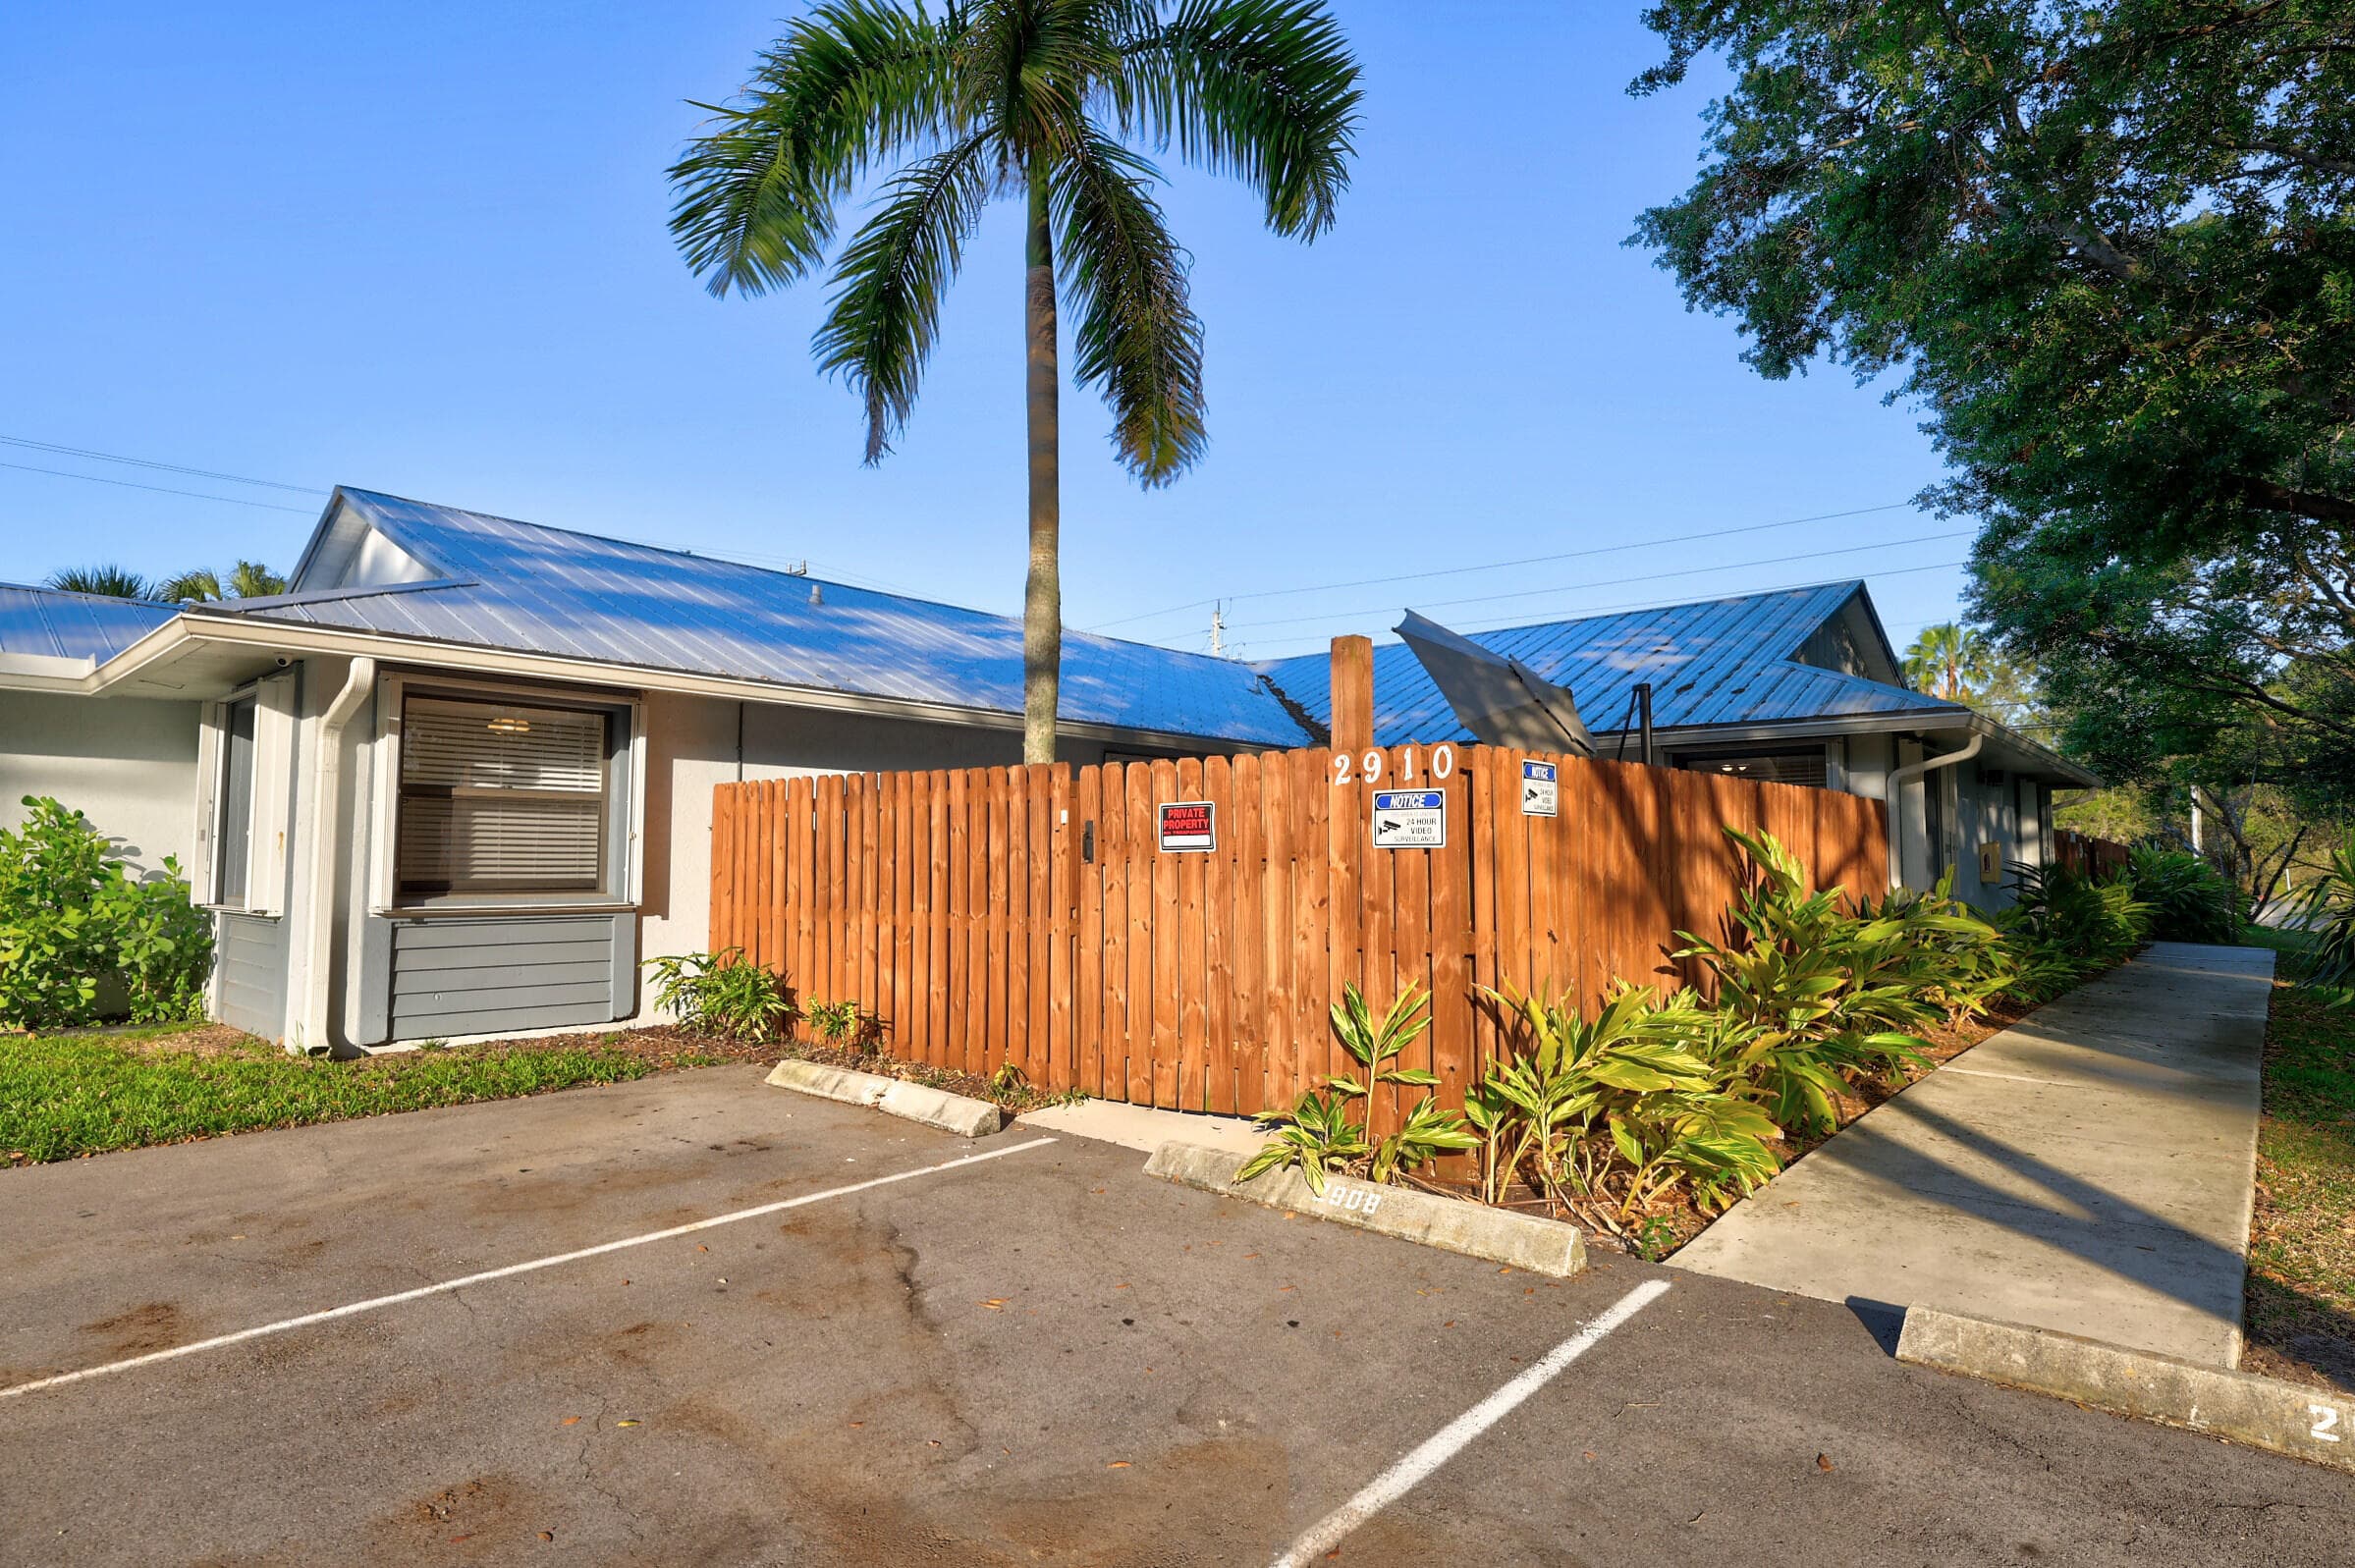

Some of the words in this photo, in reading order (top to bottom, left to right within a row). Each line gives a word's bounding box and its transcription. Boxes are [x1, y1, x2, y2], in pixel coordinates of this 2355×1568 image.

[1335, 744, 1452, 785] 2910
[1532, 766, 1549, 780] NOTICE
[1390, 793, 1426, 809] NOTICE
[1168, 808, 1205, 819] PRIVATE
[1163, 818, 1209, 830] PROPERTY
[2308, 1404, 2341, 1442] 2
